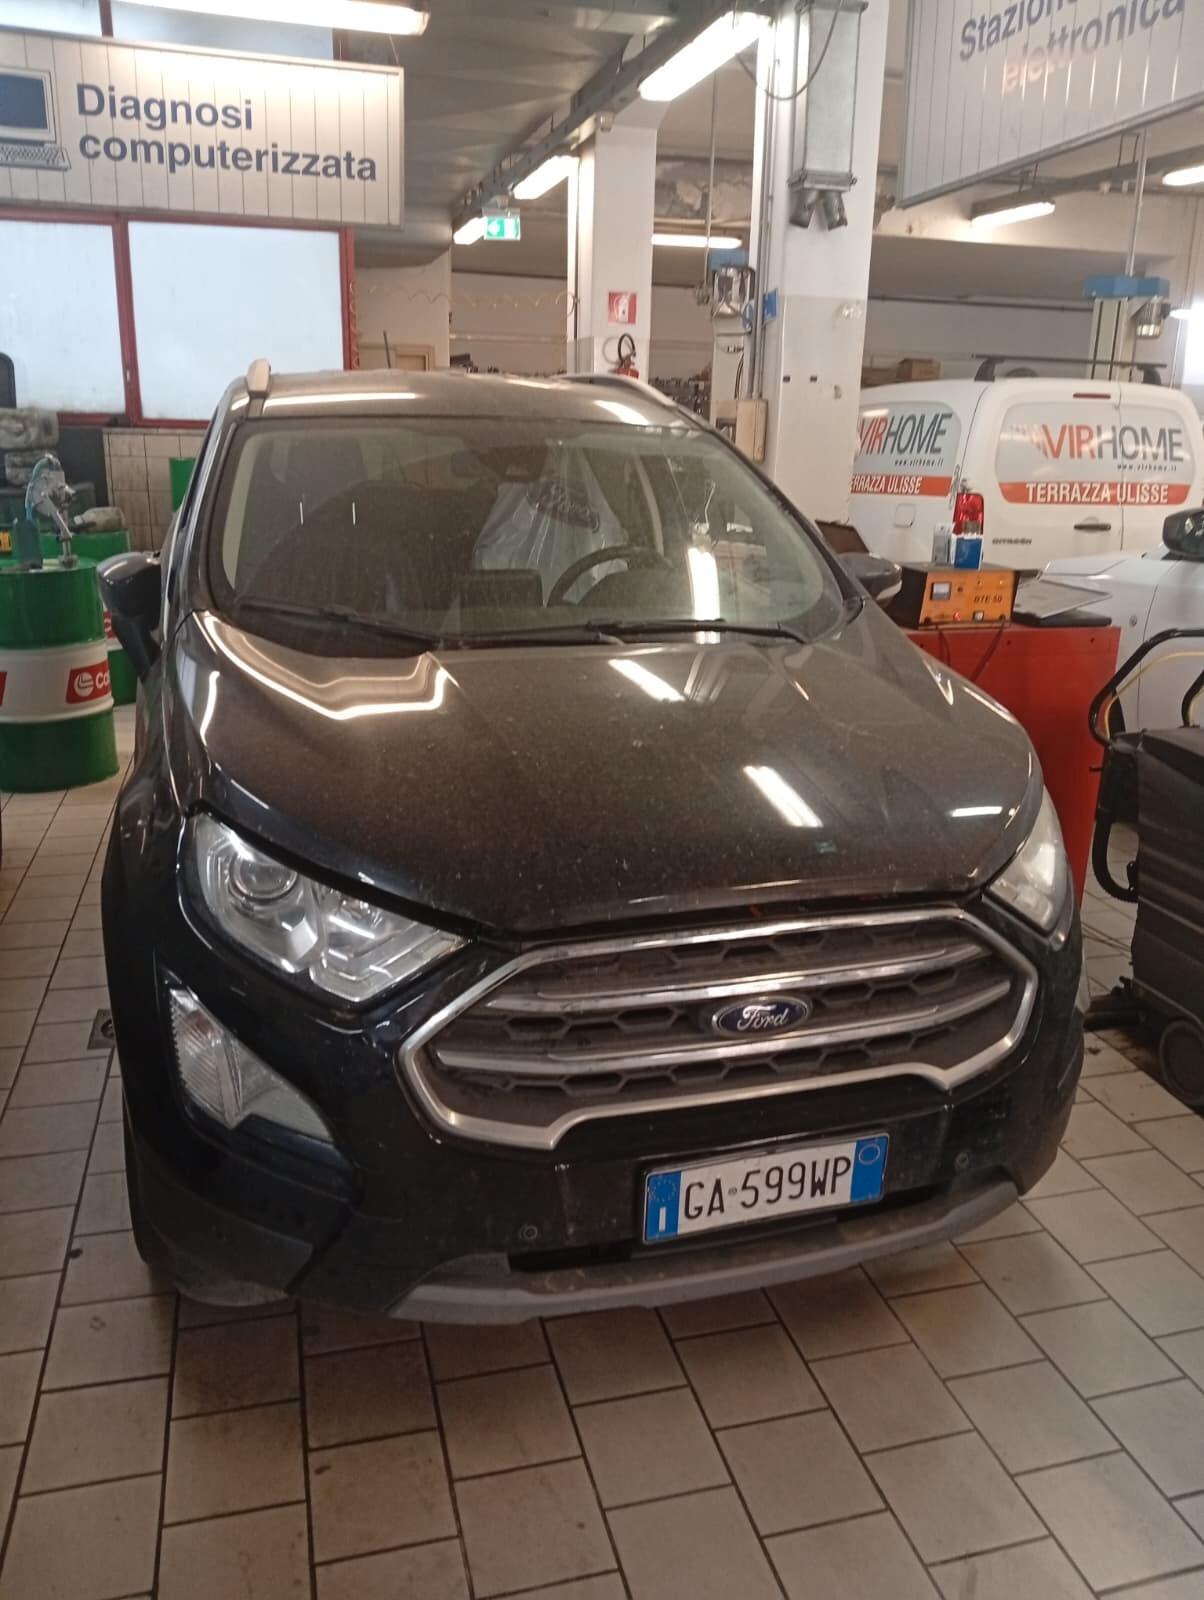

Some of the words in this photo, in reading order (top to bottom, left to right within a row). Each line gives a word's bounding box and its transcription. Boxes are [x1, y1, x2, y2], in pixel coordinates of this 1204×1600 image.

[960, 0, 1078, 61] Stazio
[76, 83, 253, 131] Diagnosi
[79, 134, 377, 182] computerizzata
[1041, 424, 1184, 462] VIRHOME
[887, 476, 922, 494] ULISSE
[1026, 482, 1111, 504] TERRAZZA
[1117, 484, 1169, 504] ULISSE
[737, 1004, 789, 1031] Ford
